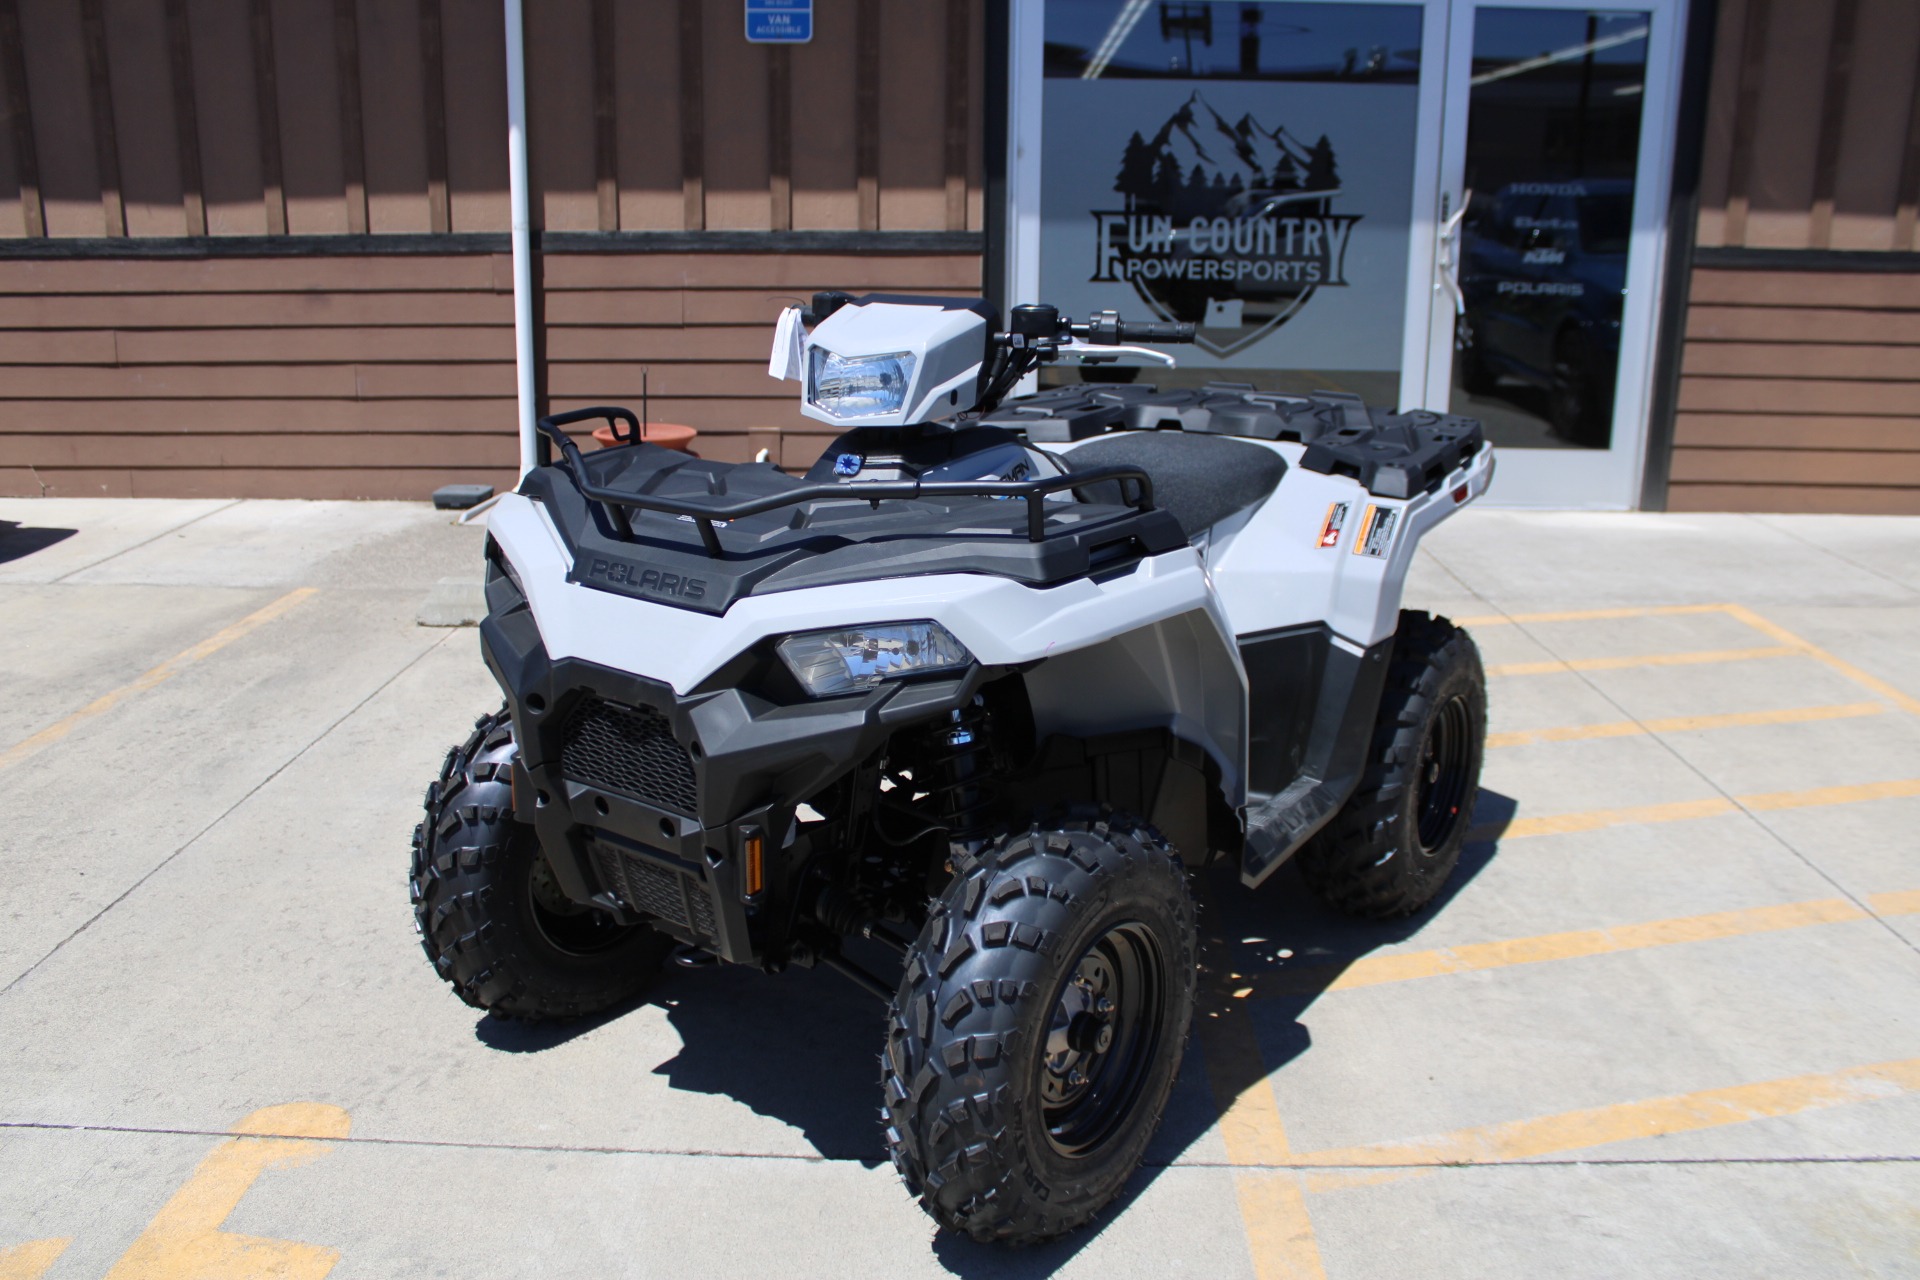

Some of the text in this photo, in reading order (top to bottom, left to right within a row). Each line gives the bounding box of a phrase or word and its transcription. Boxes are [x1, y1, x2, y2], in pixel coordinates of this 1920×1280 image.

[767, 14, 791, 24] VAN
[756, 26, 802, 34] ACCESSIBLE
[1510, 182, 1587, 196] HONDA
[1090, 211, 1361, 284] FUN COUNTRY
[1522, 248, 1566, 264] KTM
[1127, 258, 1321, 282] POWERSPORTS
[1497, 281, 1584, 296] POLARIS
[588, 558, 708, 599] POLARIS
